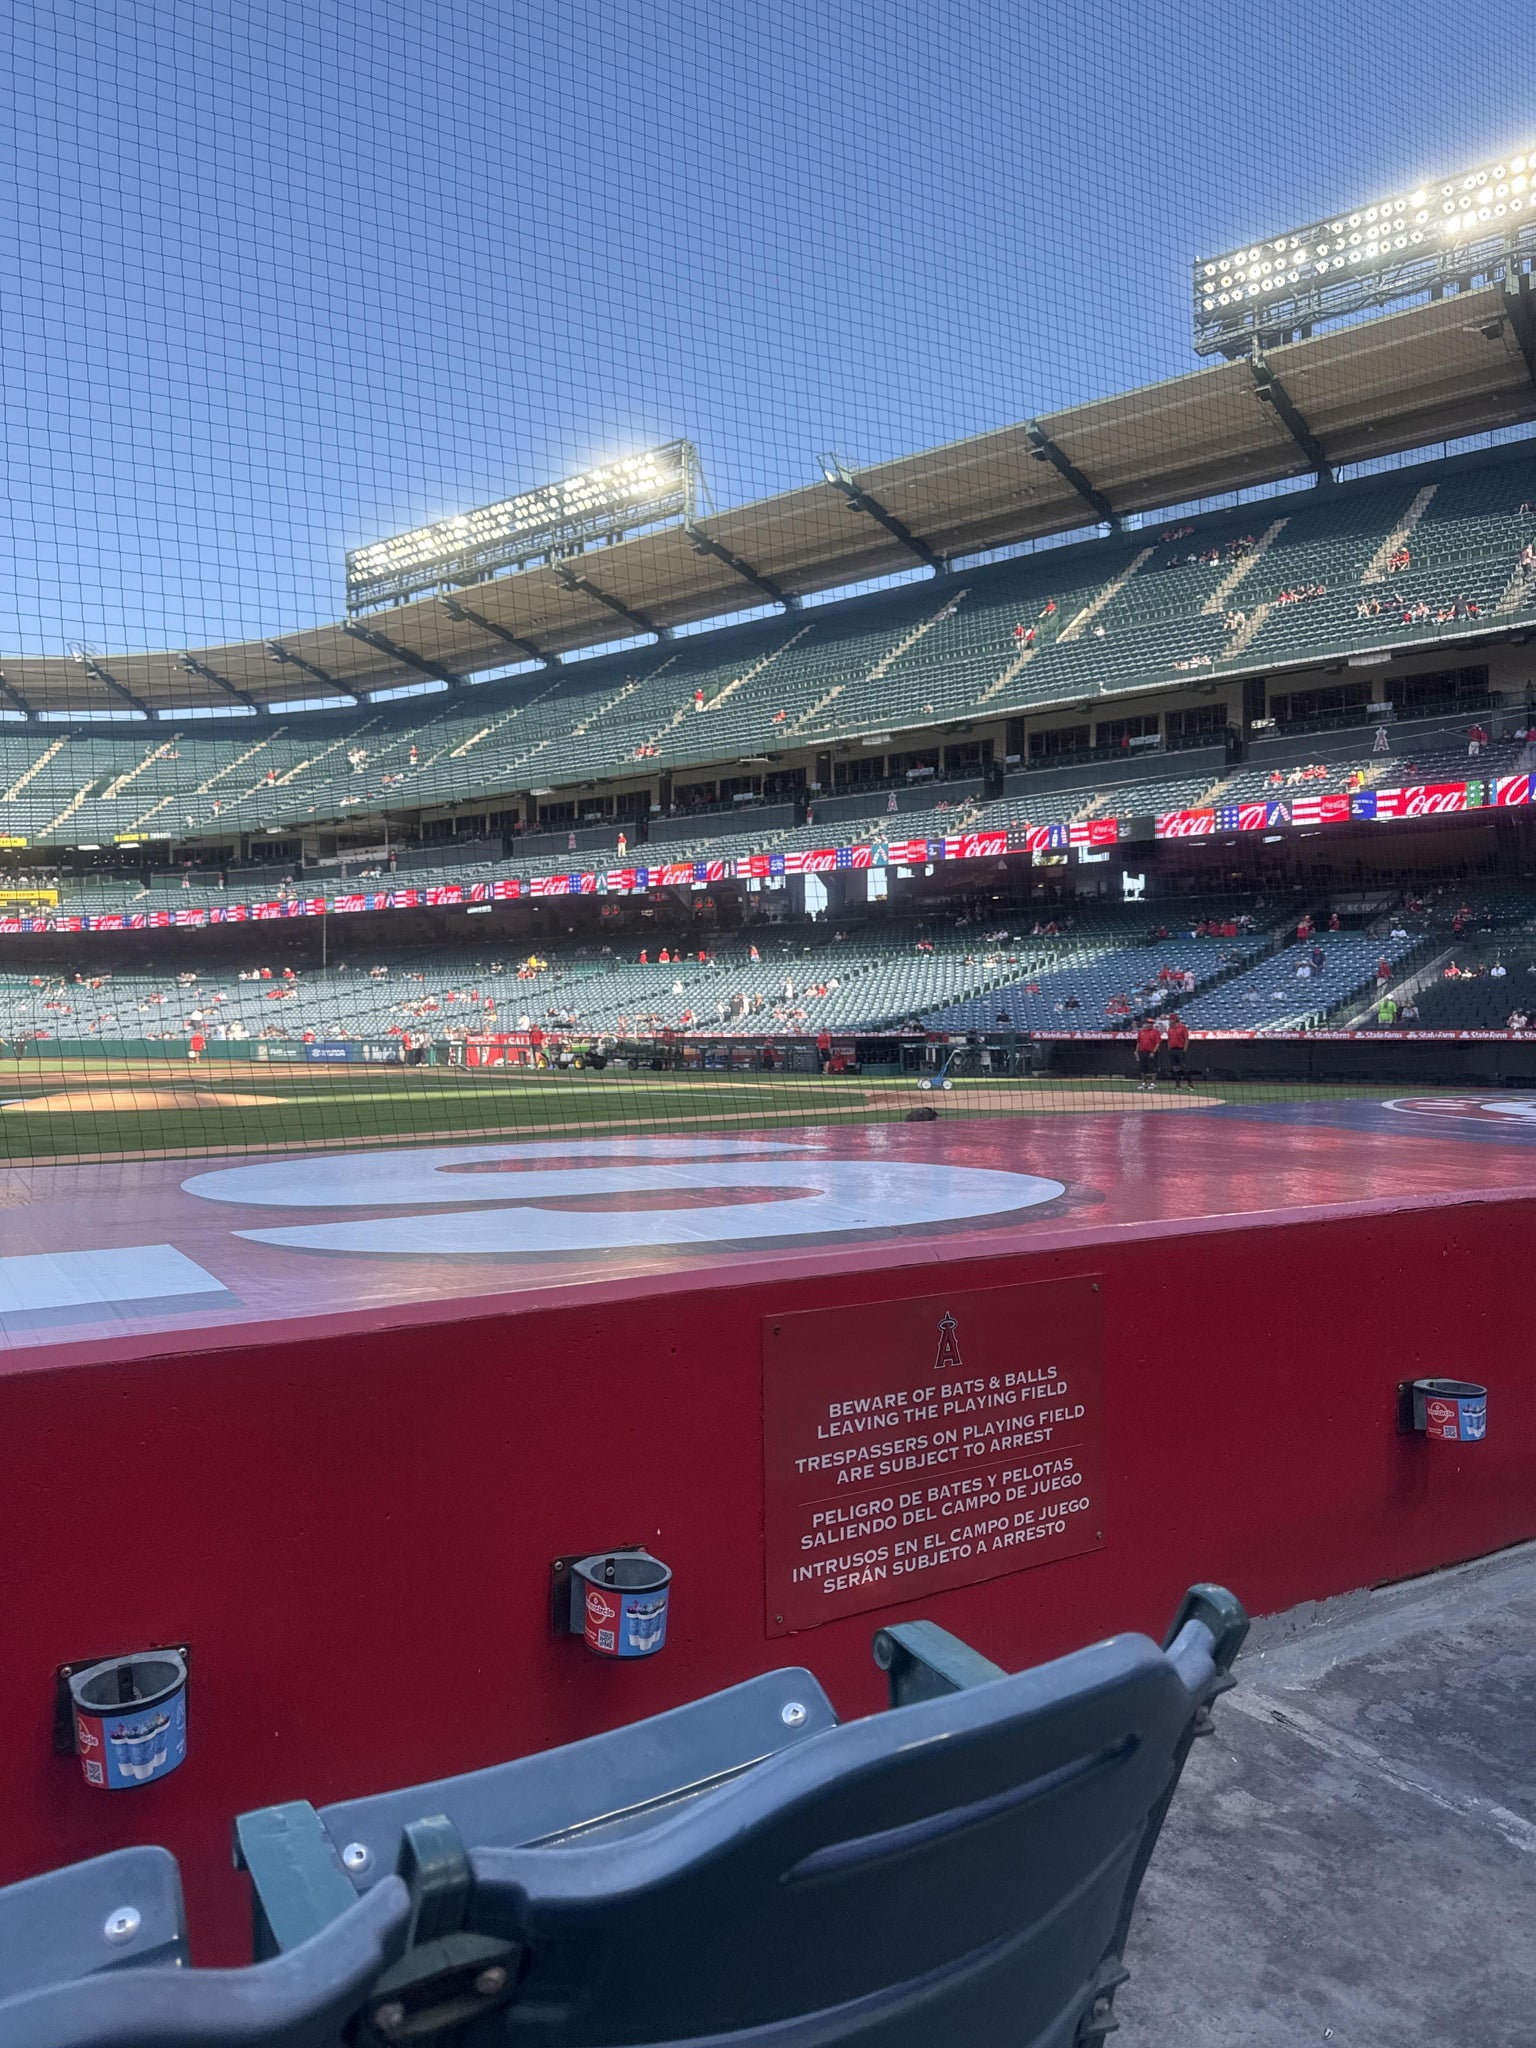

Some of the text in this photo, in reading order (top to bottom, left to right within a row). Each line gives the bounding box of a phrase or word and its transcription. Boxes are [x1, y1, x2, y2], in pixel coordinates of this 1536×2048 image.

[818, 1381, 1067, 1439] LEAVING THE PLAYING FIELD
[829, 1366, 1057, 1418] BEWARE OF BATS & BALLS
[795, 1405, 1084, 1473] TRESPASSERS ON PLAYING FIELD
[837, 1427, 1053, 1484] ARE SUBJECT TO ARREST
[801, 1473, 1082, 1550] SALIENDO DEL CAMPO DE JUEGO
[813, 1458, 1073, 1528] PELIGRO DE BATES Y PELOTAS
[793, 1497, 1089, 1583] INTRUSOS EN EL CAMPO DE JUEGO
[824, 1520, 1065, 1593] SERÁN SUBJETO A ARRESTO
